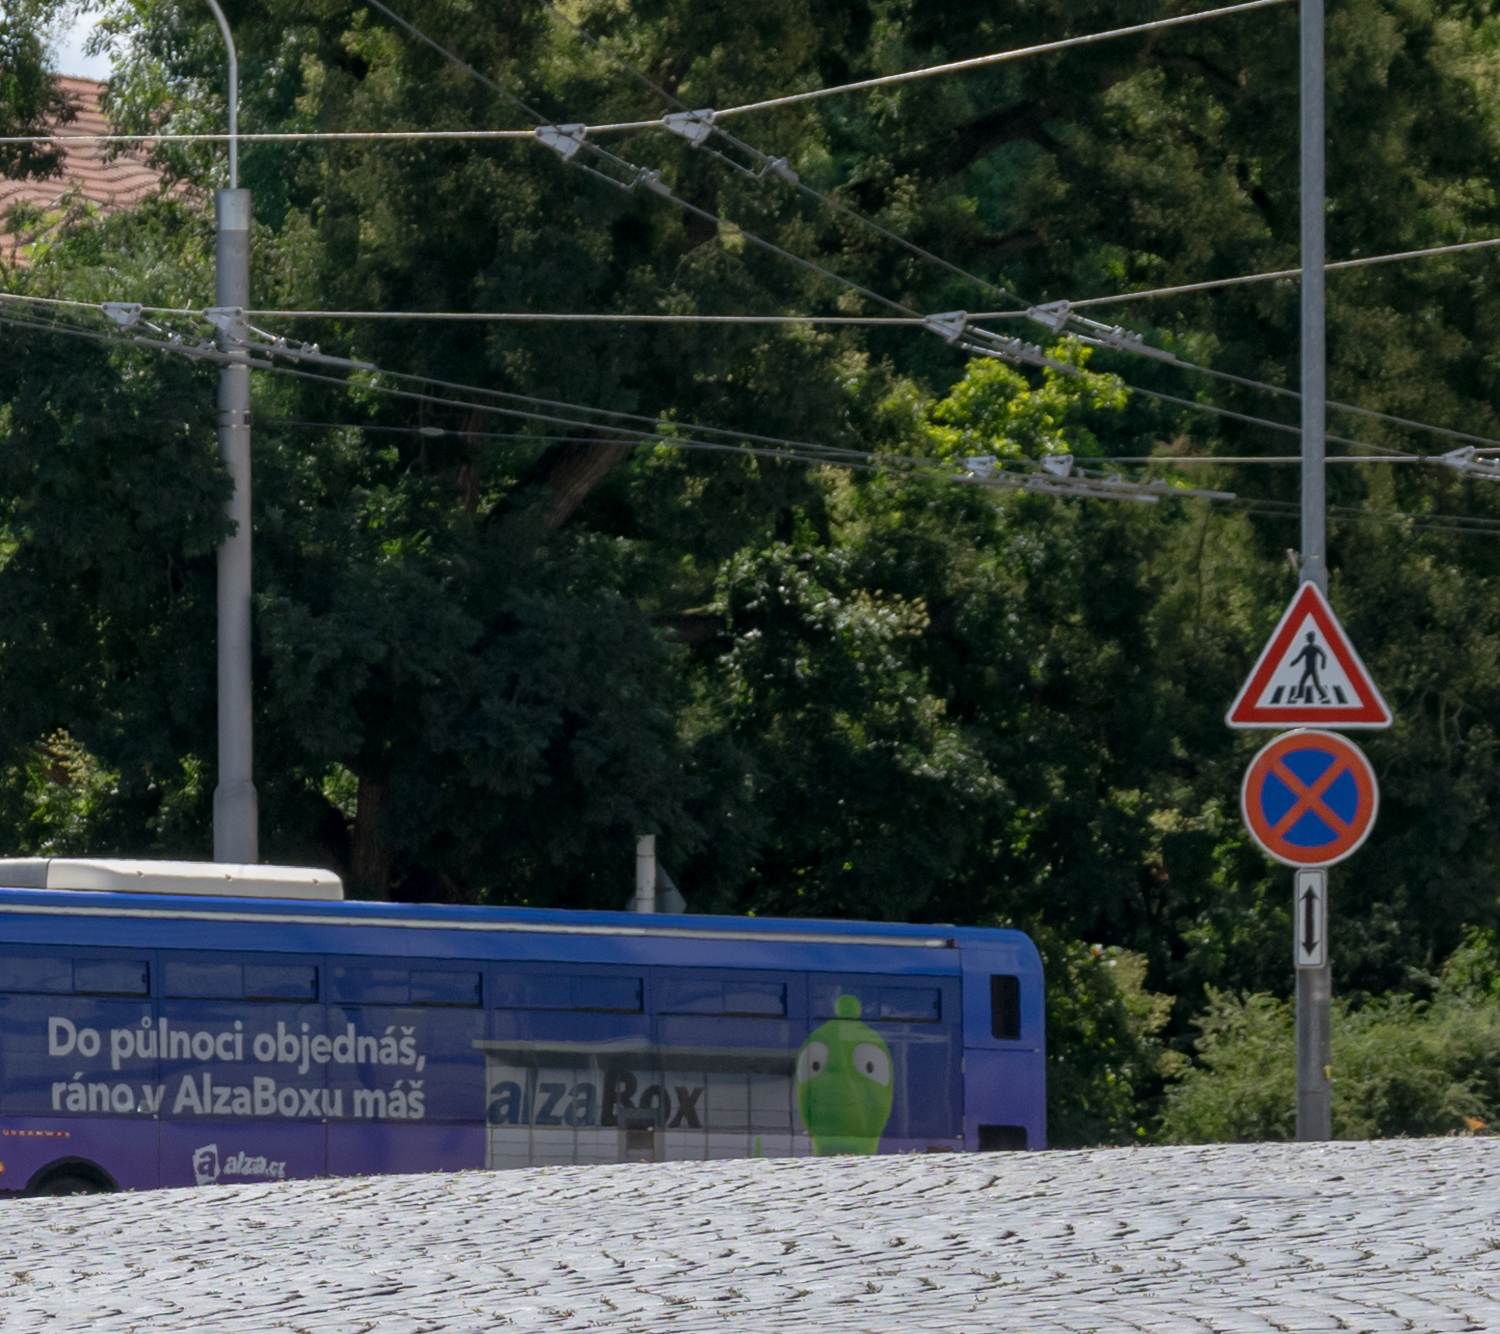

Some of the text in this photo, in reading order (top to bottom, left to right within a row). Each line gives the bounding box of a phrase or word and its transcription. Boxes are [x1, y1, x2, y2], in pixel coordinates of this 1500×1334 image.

[48, 1016, 426, 1074] Do půlnoci objednáš,
[51, 1071, 426, 1119] ráno v AlzaBoxu máš
[487, 1066, 704, 1129] alzaBox
[223, 1150, 287, 1179] alza.cz
